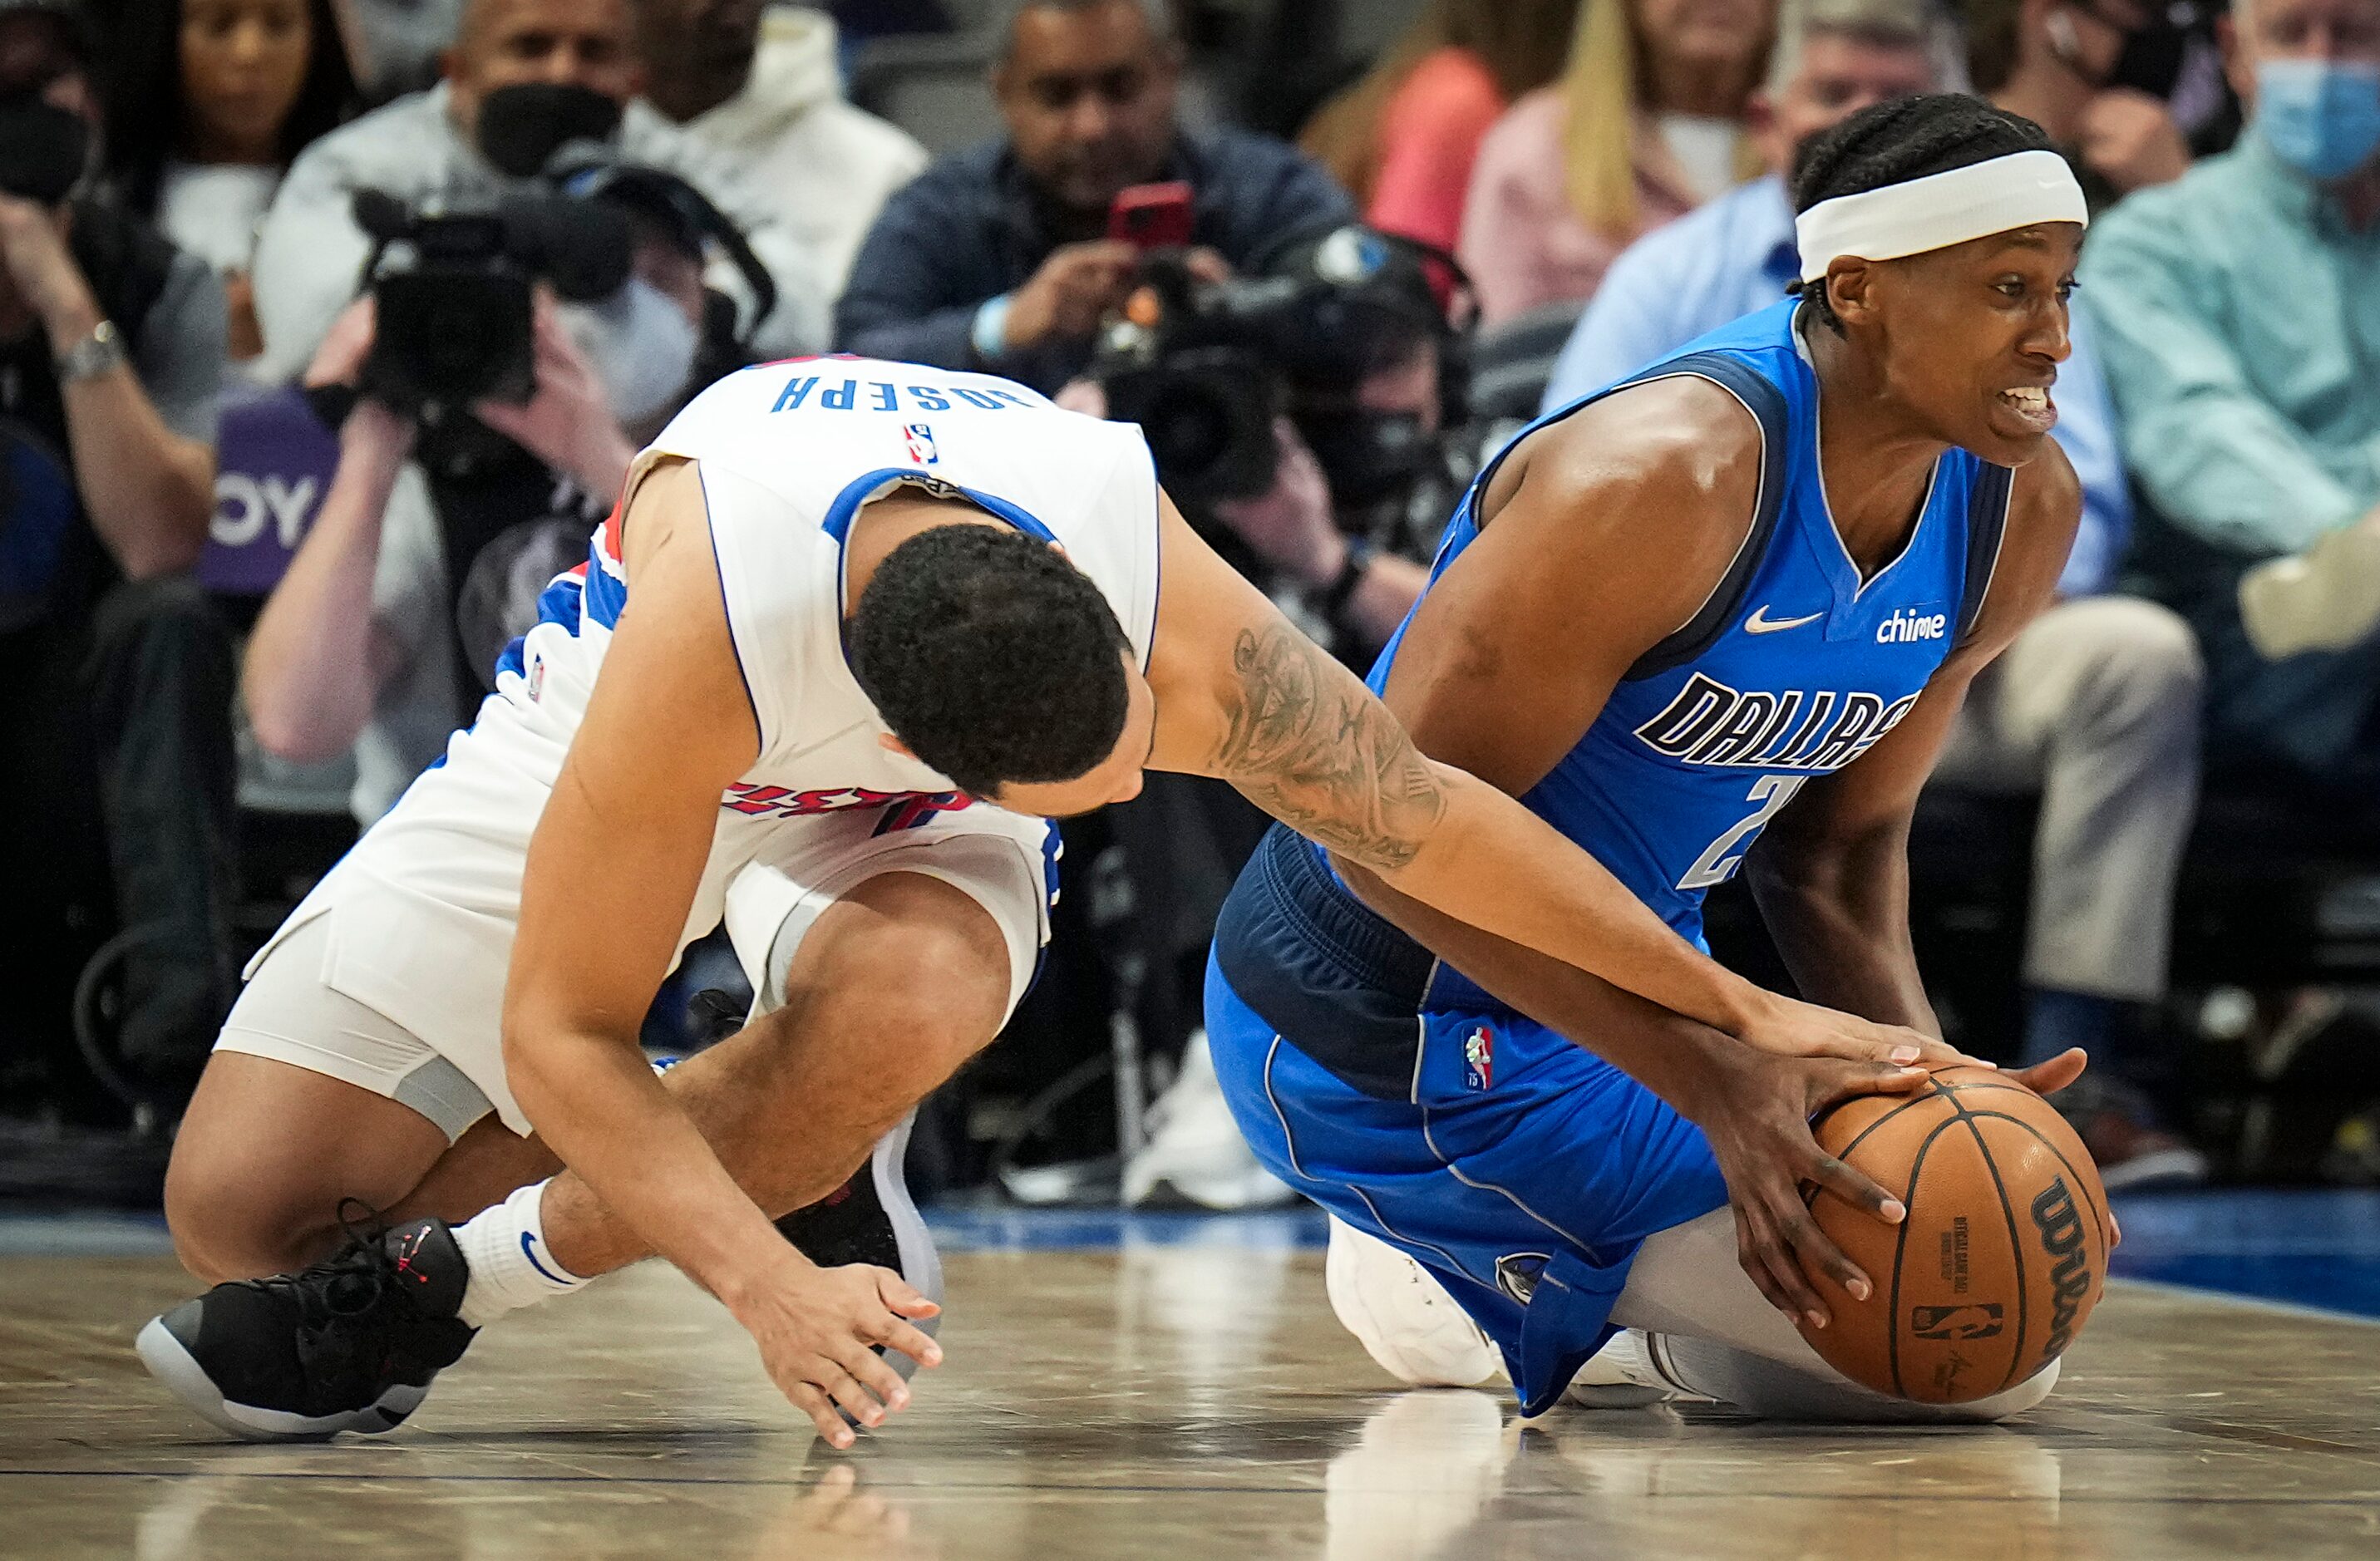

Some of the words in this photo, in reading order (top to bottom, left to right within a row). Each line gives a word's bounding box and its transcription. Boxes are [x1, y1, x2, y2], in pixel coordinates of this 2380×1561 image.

[770, 377, 1037, 414] JOSEPH
[1876, 608, 1946, 643] chime
[1633, 672, 1922, 770] DALLAS
[1675, 775, 1810, 890] 2
[2030, 1174, 2092, 1365] Wilso
